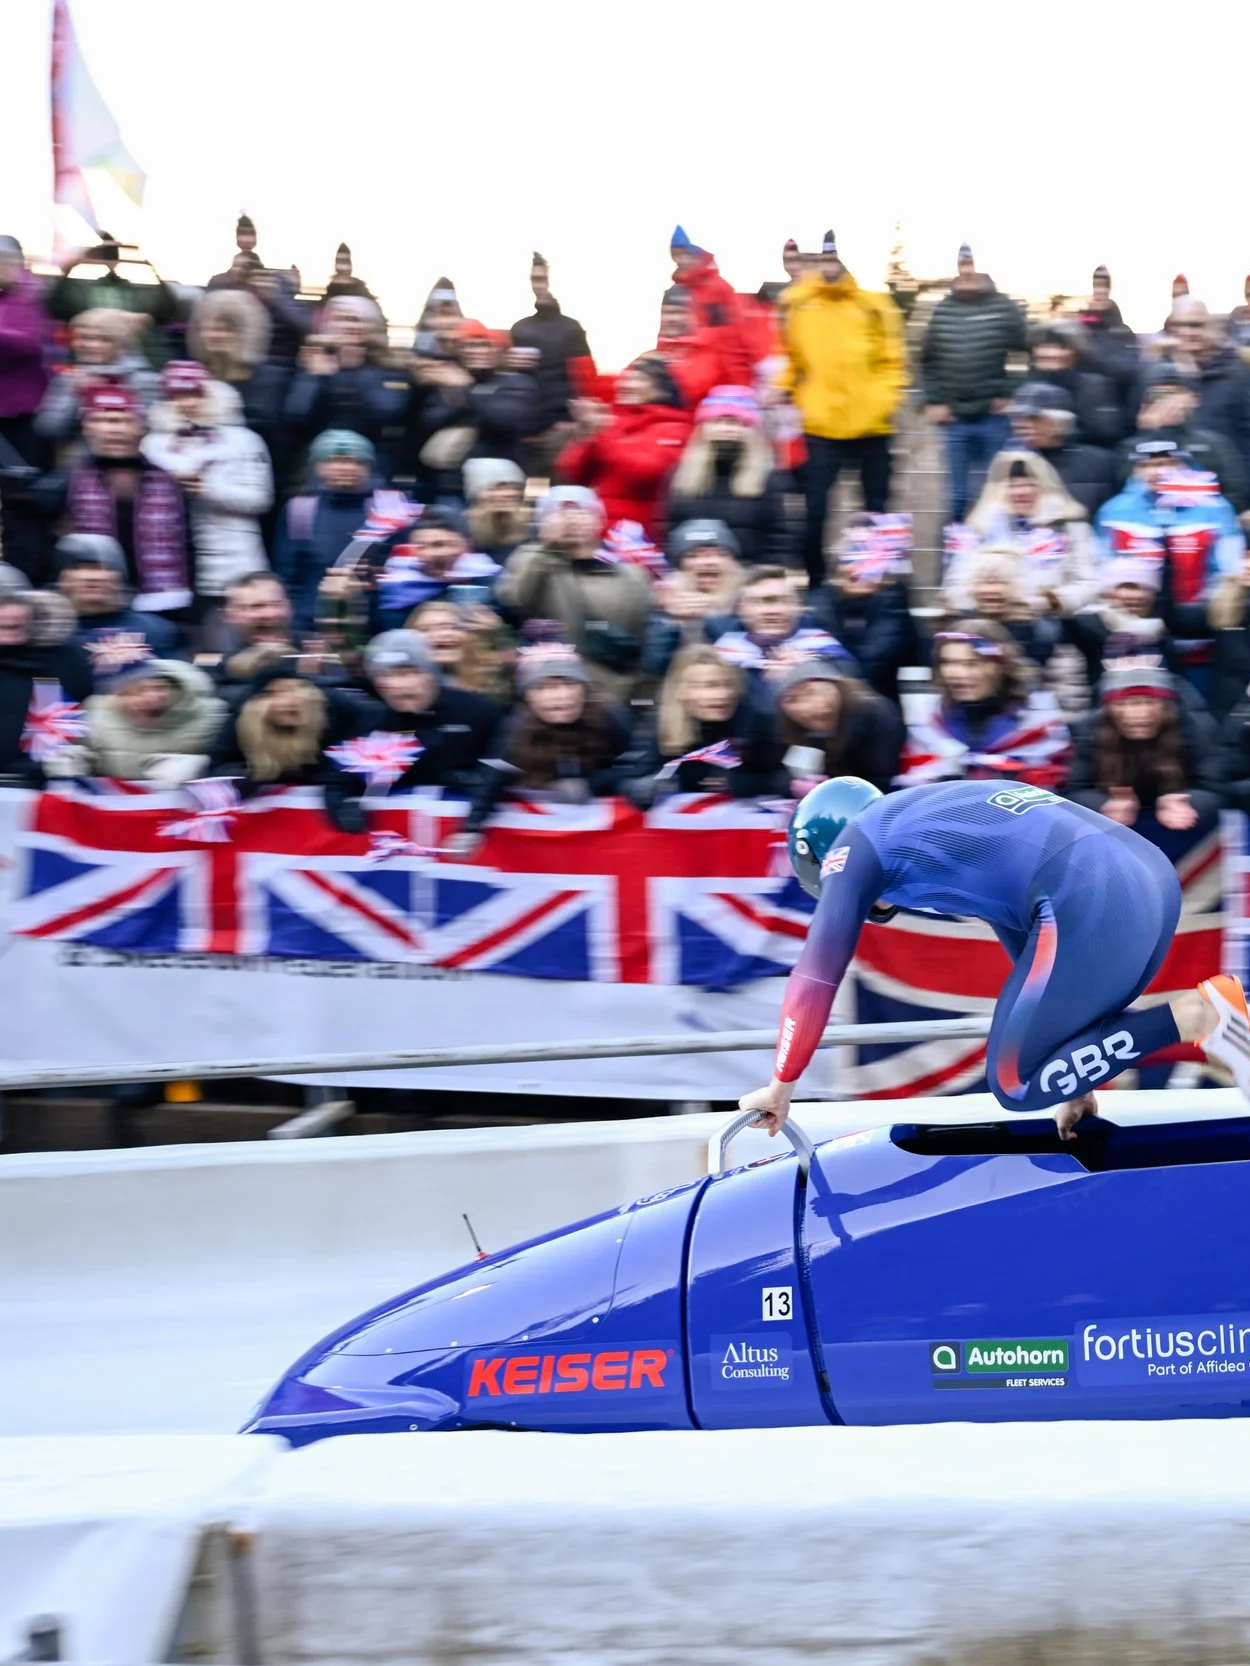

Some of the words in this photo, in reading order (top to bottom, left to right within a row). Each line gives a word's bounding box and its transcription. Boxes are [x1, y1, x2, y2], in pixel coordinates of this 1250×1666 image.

[1040, 1030, 1141, 1096] GBR
[764, 1291, 791, 1317] 13
[722, 1342, 778, 1363] Altus
[968, 1345, 1064, 1366] Autohorn
[468, 1350, 667, 1397] KEISER
[721, 1363, 790, 1380] Consulting
[1148, 1363, 1176, 1376] Part
[1179, 1361, 1193, 1374] of
[1196, 1360, 1246, 1374] Affidea
[1006, 1379, 1027, 1387] FLEET
[1028, 1377, 1065, 1387] SERVICES
